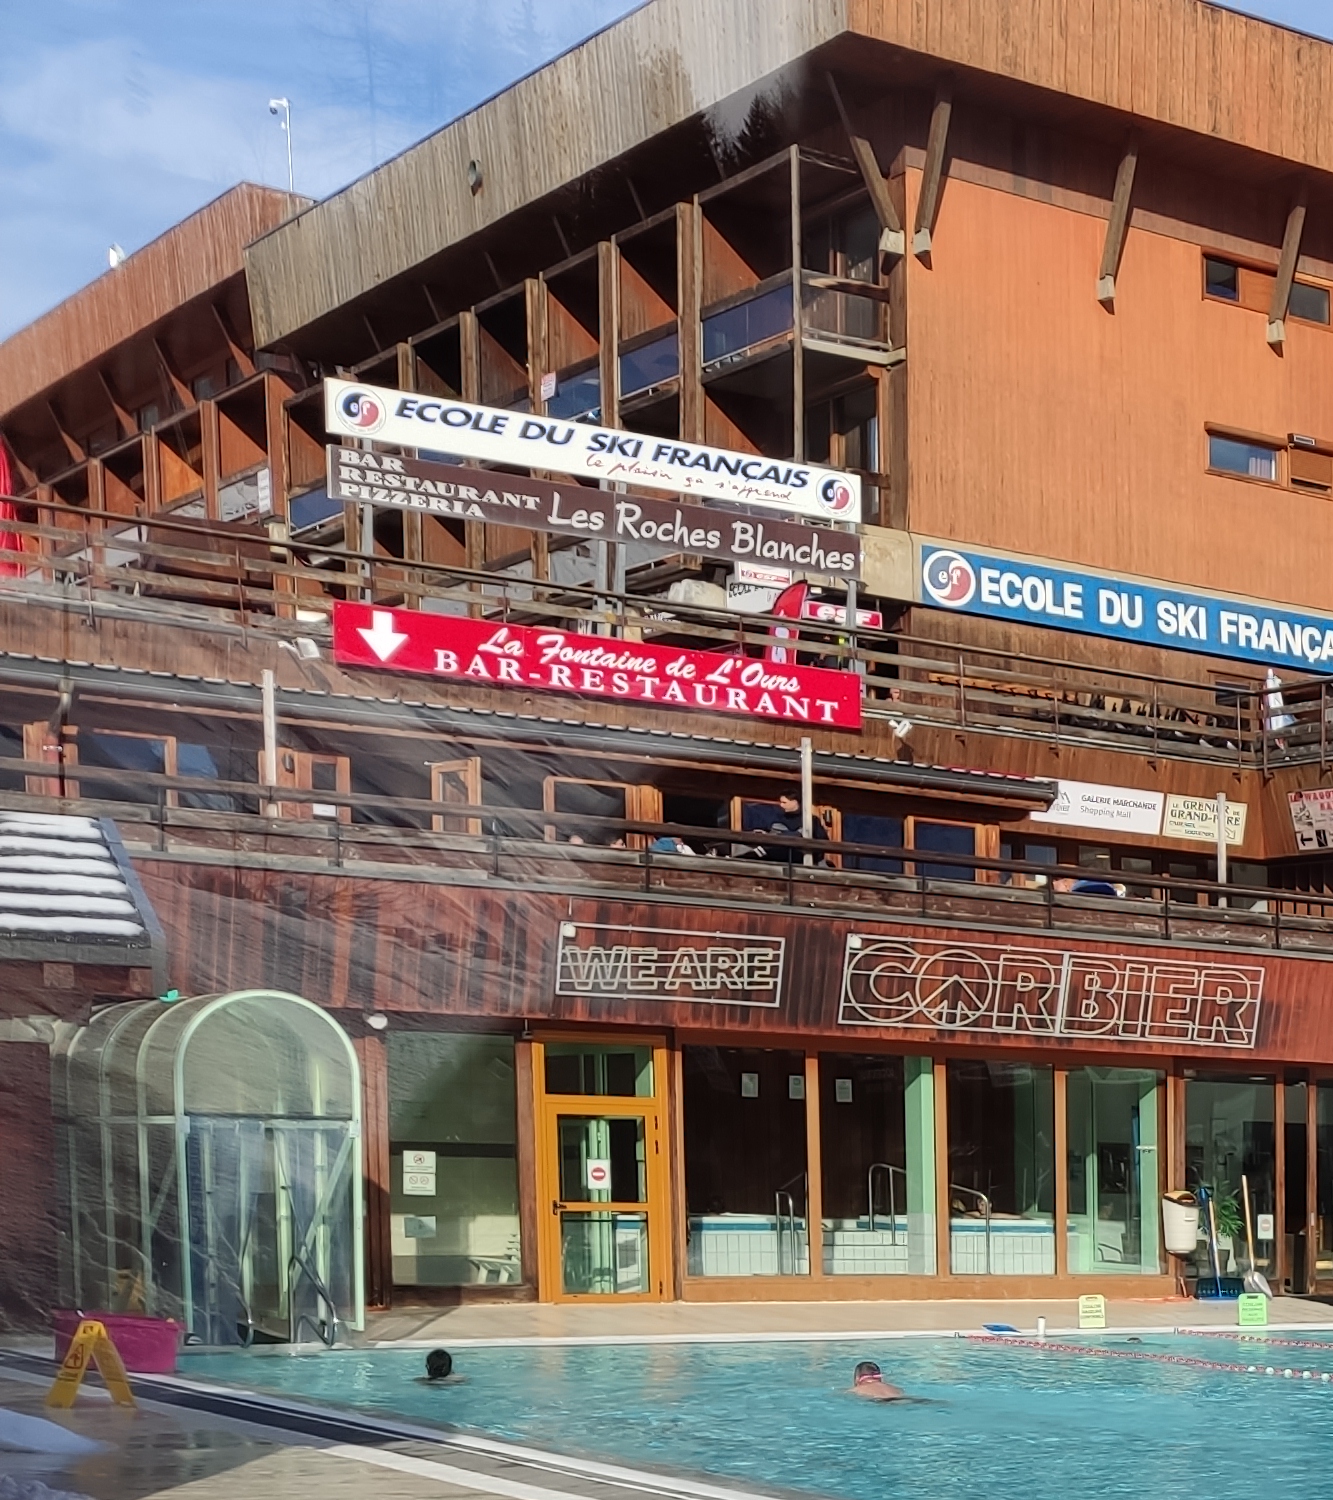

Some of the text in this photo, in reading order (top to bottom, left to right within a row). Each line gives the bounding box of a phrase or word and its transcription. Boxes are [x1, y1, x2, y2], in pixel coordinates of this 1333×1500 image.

[339, 449, 406, 474] BAR
[395, 398, 509, 435] ECOLE
[518, 420, 575, 445] DU
[586, 432, 643, 458] SKI
[652, 443, 811, 489] FRANÇAIS
[339, 465, 541, 511] RESTAURANT
[339, 482, 487, 519] PIZZERIA
[547, 491, 856, 572] Les Roches Blanches
[980, 568, 1084, 619] ECOLE
[1099, 590, 1143, 629] DU
[1157, 600, 1207, 641] SKI
[434, 648, 839, 723] BAR-RESTAURANT
[478, 627, 801, 692] La Fontaine de L'Ours
[1080, 805, 1115, 818] Shopping
[1116, 810, 1132, 819] Mall
[1170, 809, 1241, 827] GRAND-PRE
[1183, 800, 1230, 815] GRENIR
[846, 943, 1253, 1044] CORBIER
